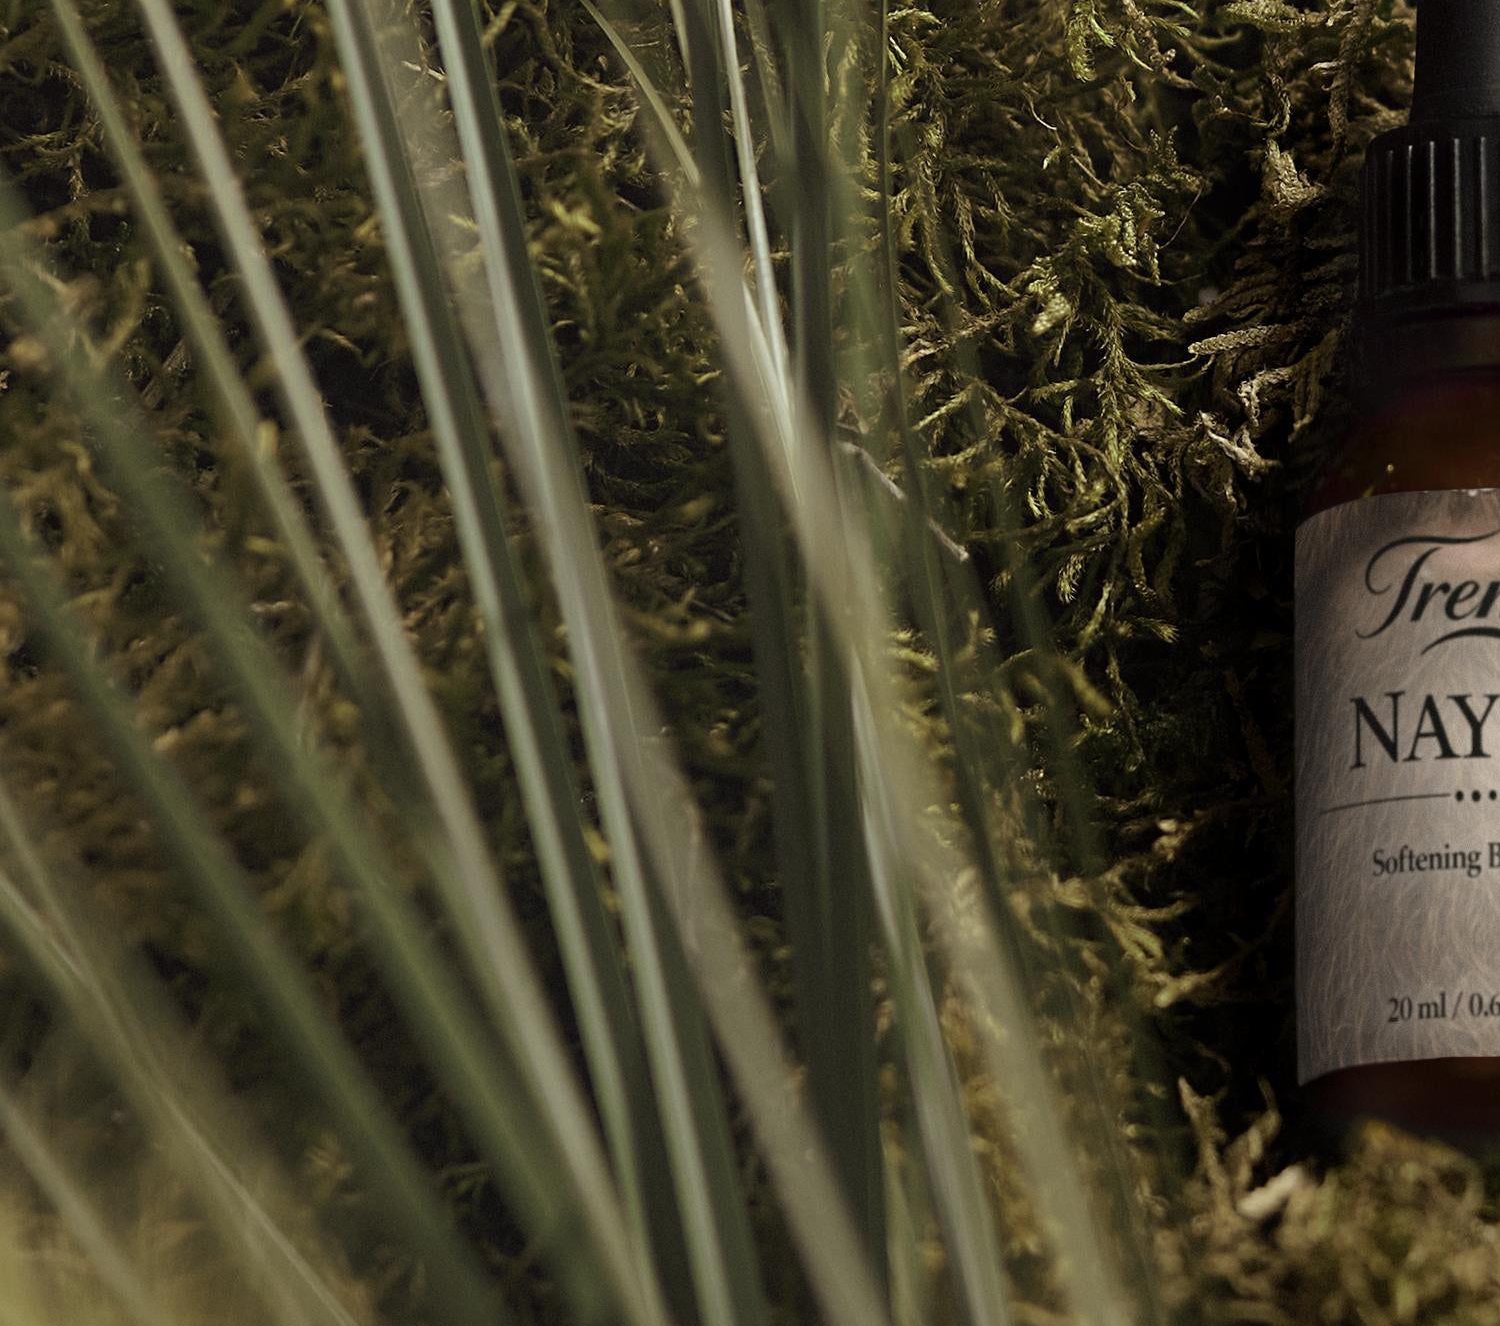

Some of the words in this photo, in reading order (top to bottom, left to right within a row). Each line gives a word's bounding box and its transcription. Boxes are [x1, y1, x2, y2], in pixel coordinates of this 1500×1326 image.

[1372, 844, 1482, 877] Softening
[1387, 997, 1413, 1023] 20
[1417, 992, 1446, 1020] ml
[1451, 992, 1464, 1020] /
